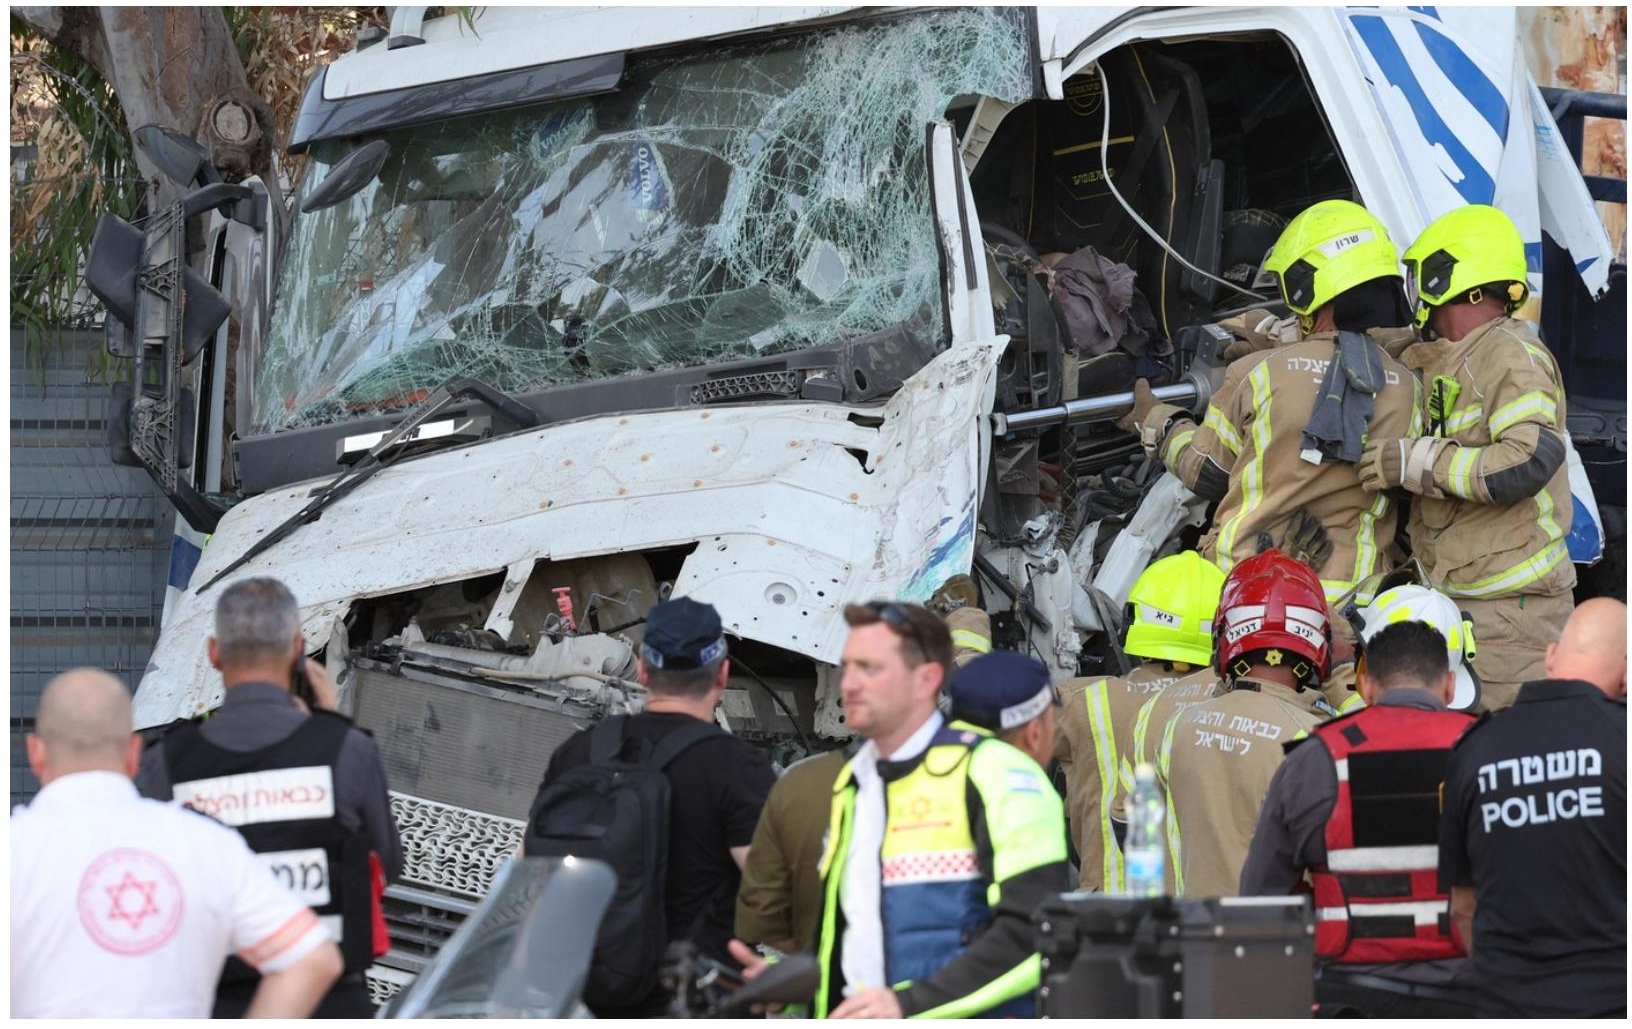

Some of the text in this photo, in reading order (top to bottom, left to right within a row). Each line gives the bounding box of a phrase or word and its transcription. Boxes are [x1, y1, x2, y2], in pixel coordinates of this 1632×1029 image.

[638, 147, 652, 203] VOLVO
[1335, 234, 1360, 250] שרון
[1156, 612, 1174, 623] גיא
[1229, 622, 1257, 640] דניאל
[1294, 625, 1314, 637] יניב
[1228, 715, 1282, 740] כבאות
[1194, 729, 1251, 755] לישראל
[1478, 748, 1602, 793] משטרה
[184, 784, 326, 816] כבאות והצל
[1481, 786, 1605, 833] POLICE
